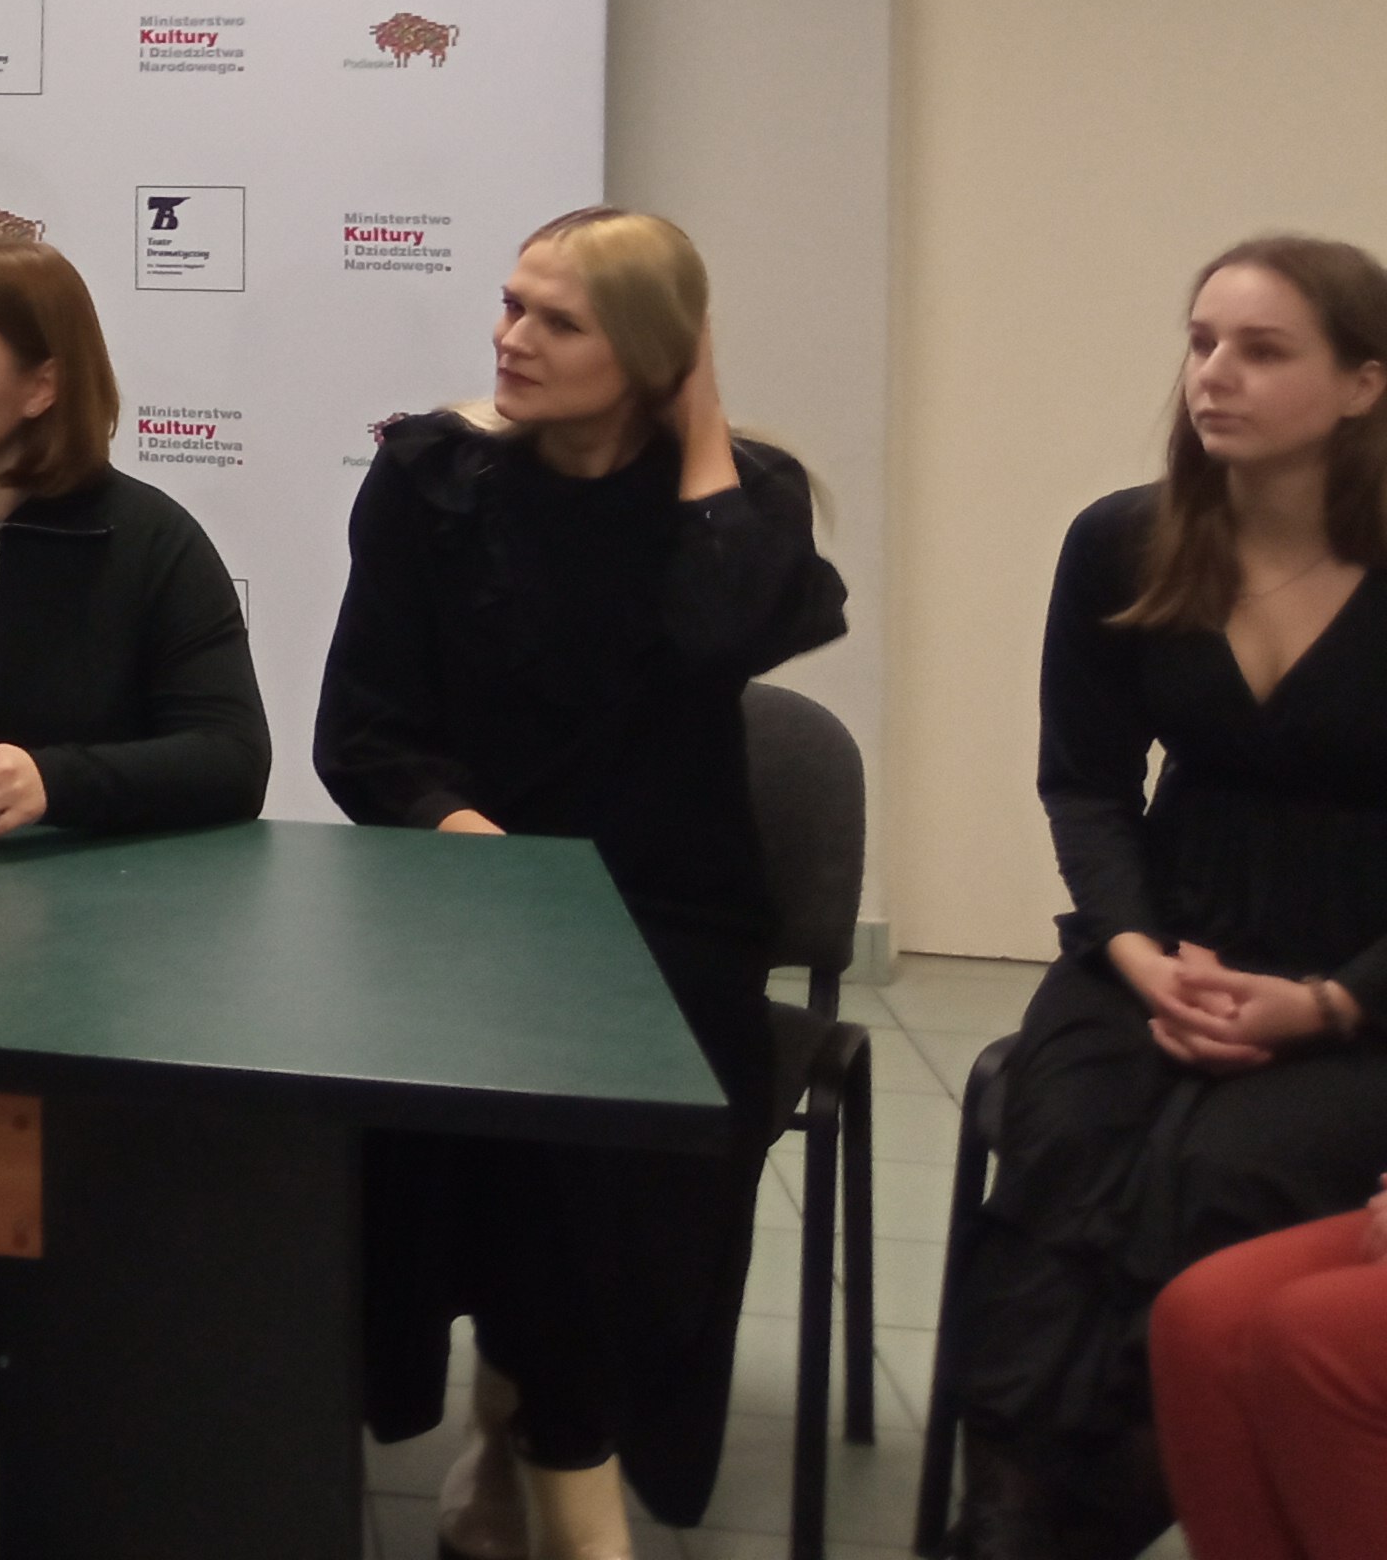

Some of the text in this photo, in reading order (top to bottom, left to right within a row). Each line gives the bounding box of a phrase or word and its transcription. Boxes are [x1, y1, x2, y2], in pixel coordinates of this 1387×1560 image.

[139, 16, 245, 27] Ministerstwo
[139, 29, 219, 47] Kultury
[343, 212, 452, 226] Ministerstwo
[343, 226, 425, 246] Kultury
[137, 406, 243, 420] Ministerstwo
[137, 420, 216, 439] Kultury
